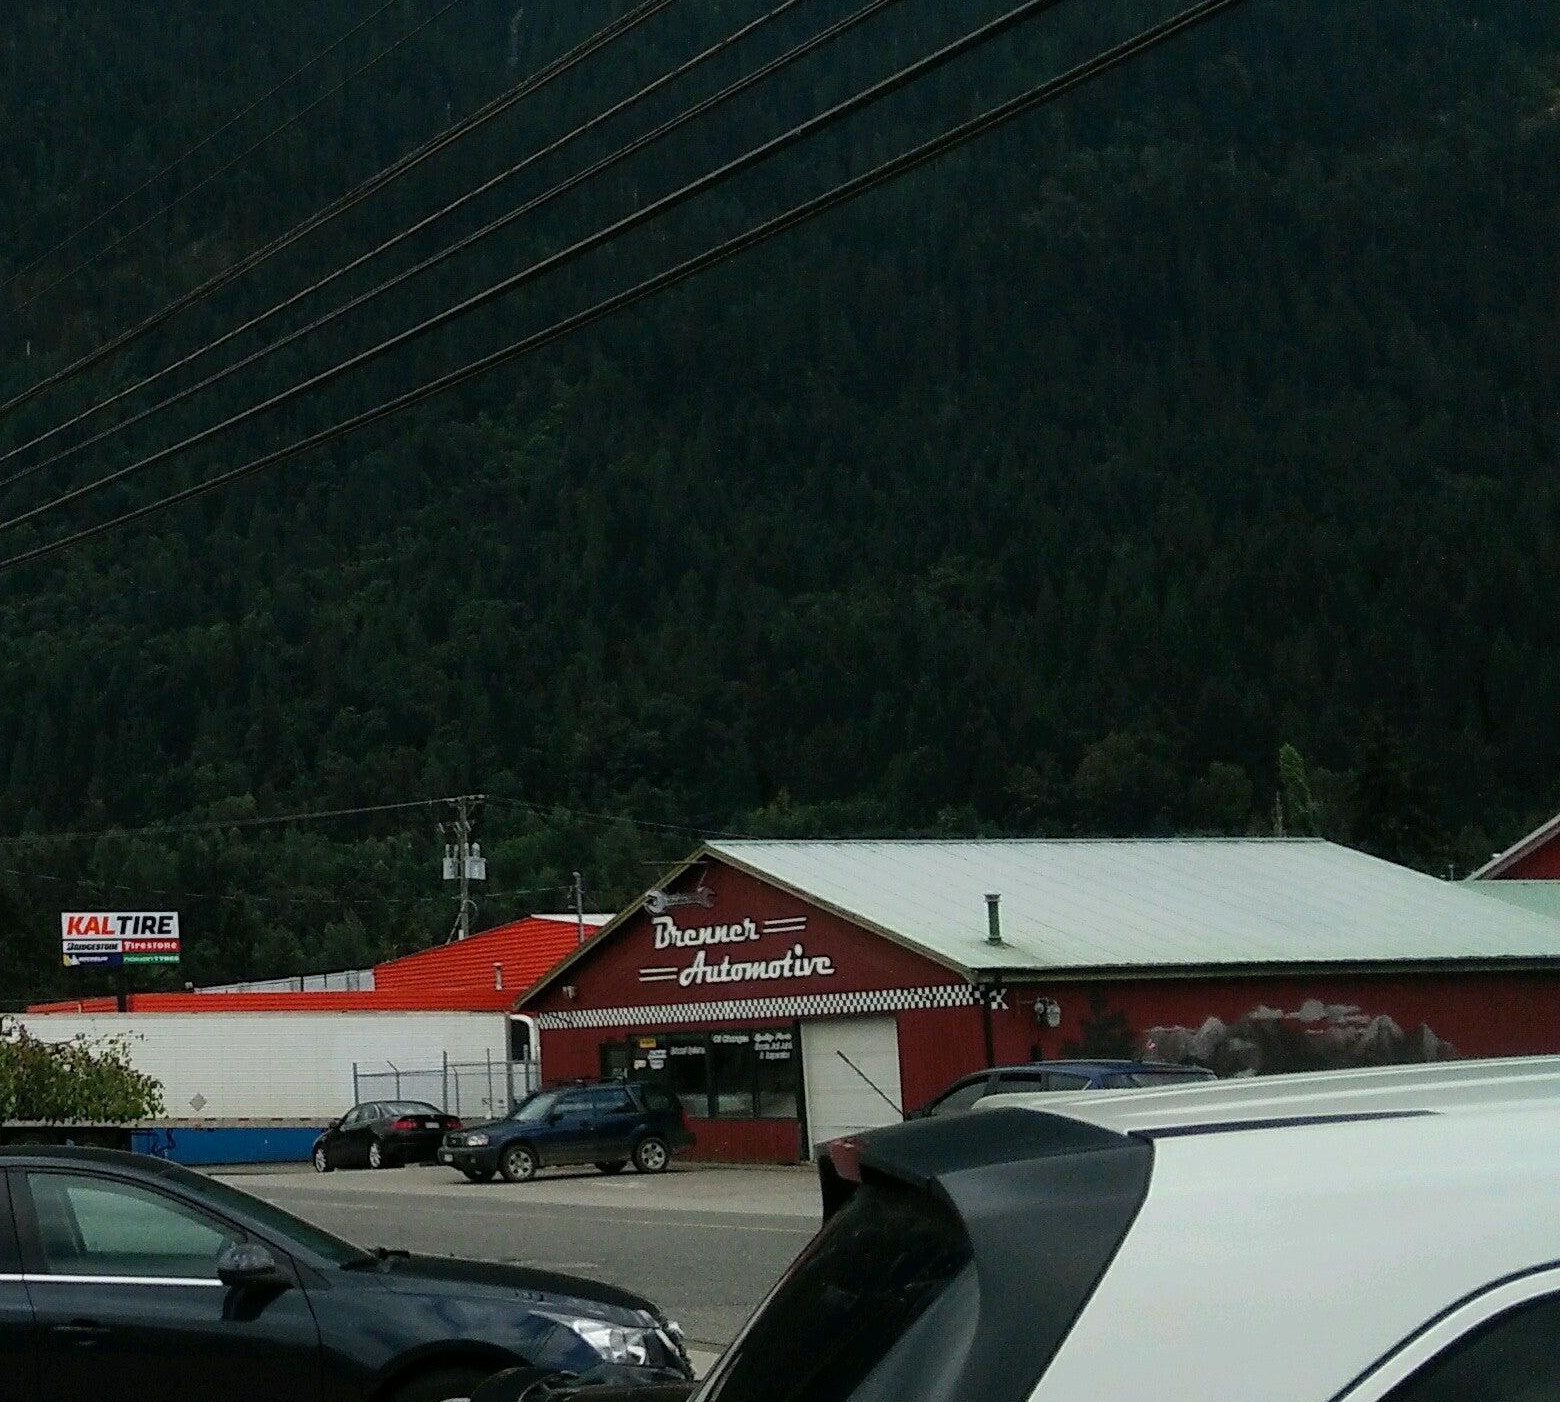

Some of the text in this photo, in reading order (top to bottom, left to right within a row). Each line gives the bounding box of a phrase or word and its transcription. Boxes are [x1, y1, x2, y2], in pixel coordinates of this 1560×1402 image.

[124, 941, 178, 952] Firestone
[651, 915, 761, 949] Brenner
[678, 943, 836, 987] Automotive
